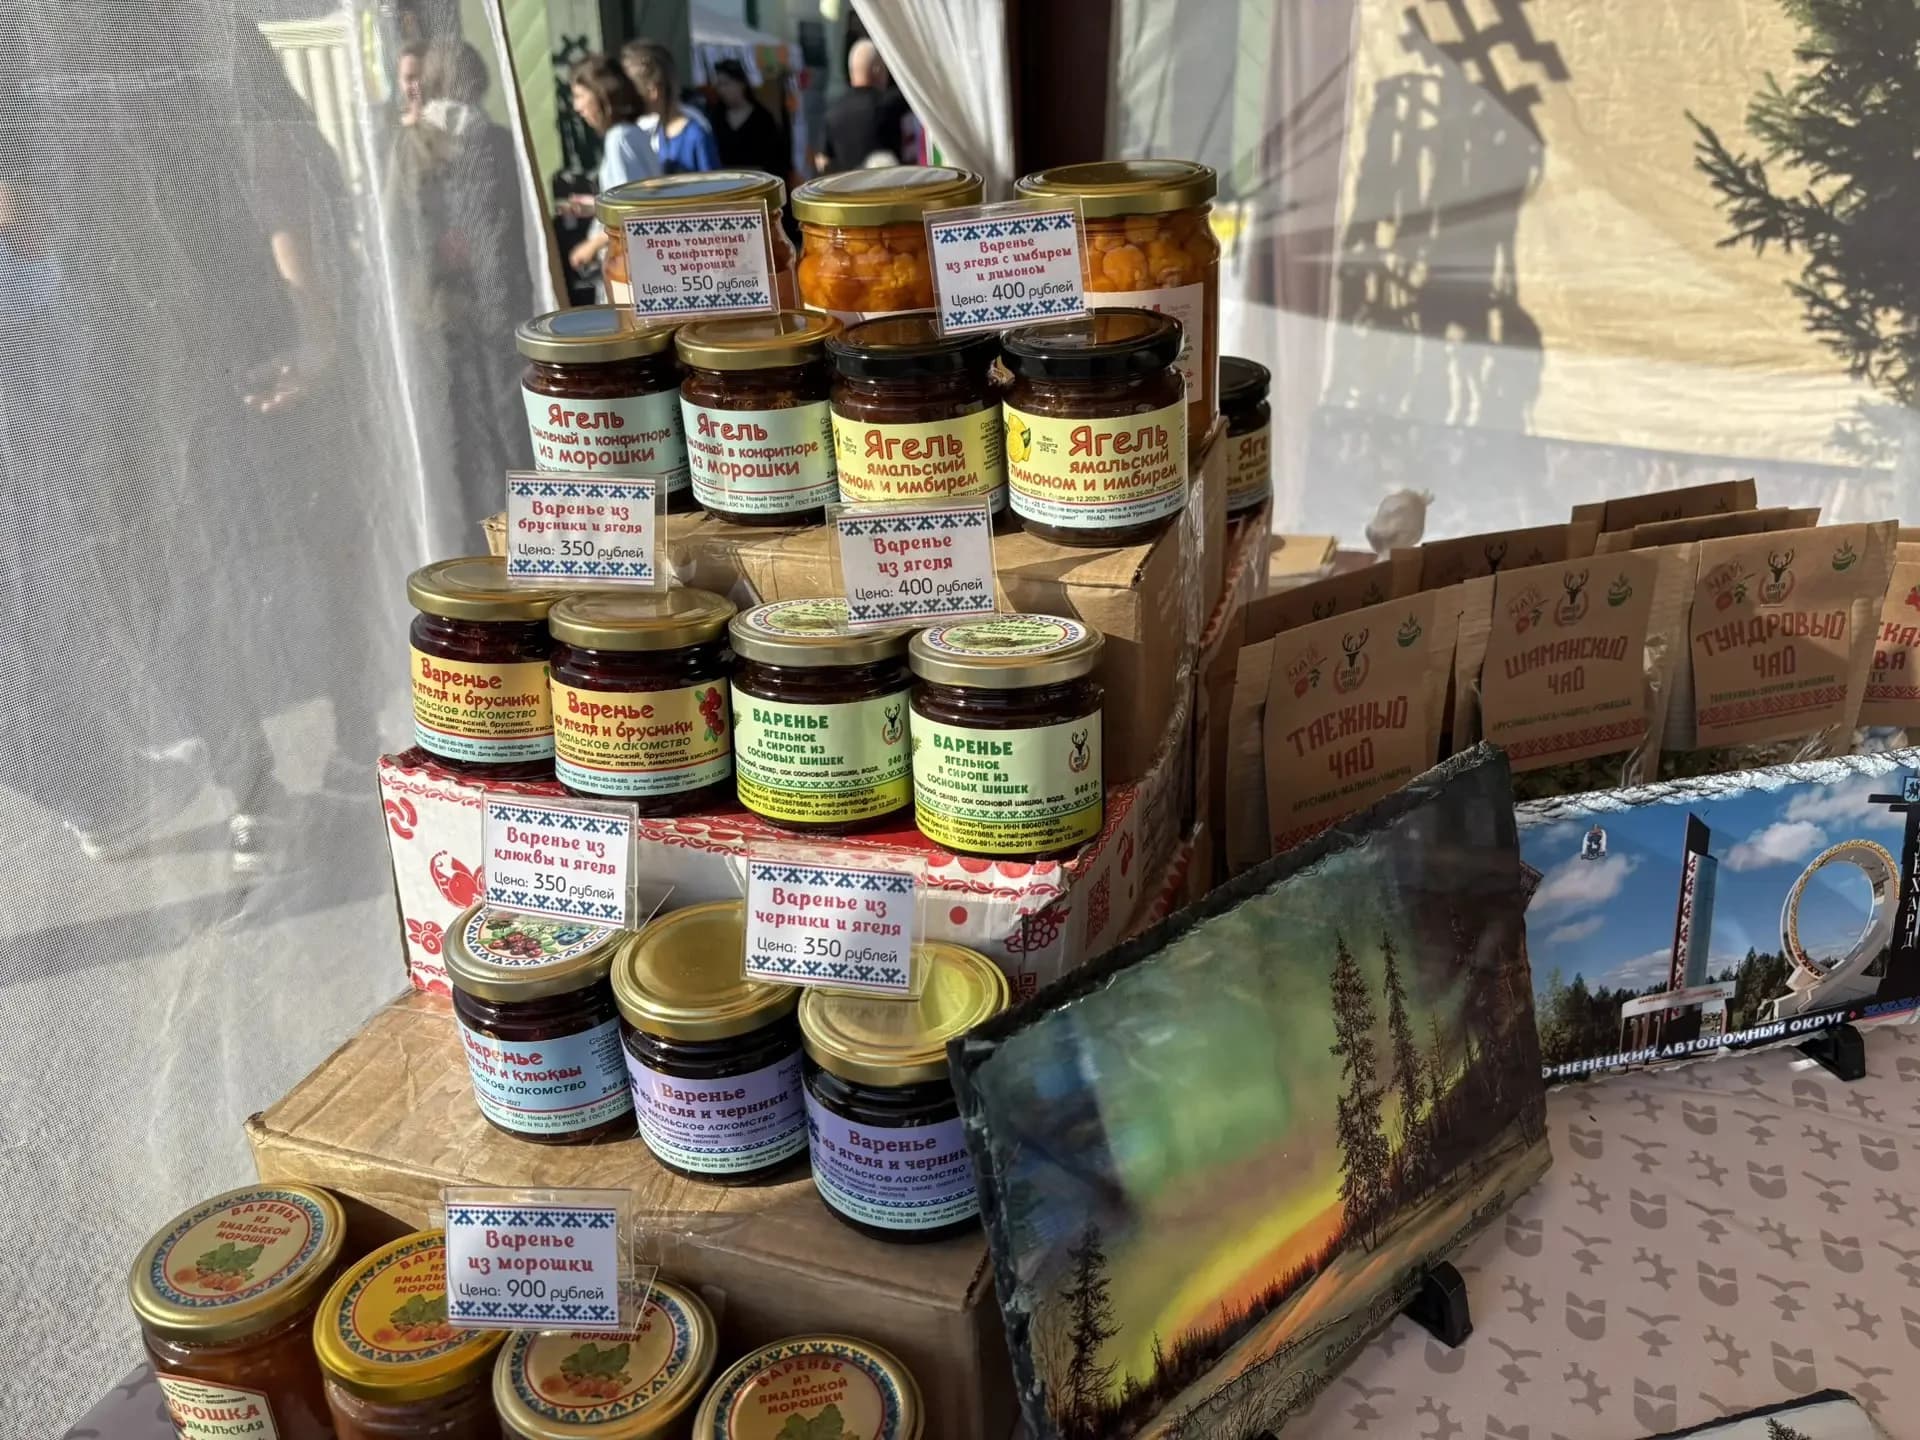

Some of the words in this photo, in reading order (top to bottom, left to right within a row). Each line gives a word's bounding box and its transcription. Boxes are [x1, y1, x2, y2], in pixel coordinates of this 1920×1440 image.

[647, 238, 681, 249] Ягель
[685, 233, 745, 246] томленый
[980, 237, 1034, 253] Варенье
[656, 249, 664, 260] в
[668, 247, 739, 261] конфитюре
[945, 261, 960, 274] из
[963, 256, 998, 270] ягеля
[1003, 254, 1009, 264] с
[1013, 247, 1072, 263] имбирем
[663, 264, 677, 275] из
[680, 259, 735, 273] морошки
[977, 271, 984, 281] и
[988, 264, 1045, 281] лимоном
[642, 283, 677, 295] Цена:
[682, 275, 713, 291] 550
[717, 276, 759, 293] рублей
[951, 293, 987, 308] Цена:
[992, 281, 1025, 300] 400
[1029, 280, 1074, 298] рублей
[548, 403, 625, 430] Ягель
[697, 412, 768, 442] Ягель
[584, 435, 591, 445] в
[595, 427, 672, 448] конфитюре
[865, 429, 963, 460] Ягель
[1069, 424, 1168, 457] Ягель
[539, 443, 553, 459] из
[559, 448, 655, 470] морошки
[728, 448, 735, 457] в
[739, 441, 819, 462] конфитюре
[1070, 445, 1169, 474] ямальский
[692, 454, 703, 470] из
[707, 461, 800, 482] морошки
[867, 454, 966, 477] ямальский
[880, 481, 890, 493] и
[897, 473, 978, 496] имбирем
[1010, 464, 1077, 491] лимоном
[1083, 479, 1096, 491] и
[1103, 464, 1177, 491] имбирем
[532, 500, 605, 518] Варенье
[611, 505, 630, 521] из
[518, 518, 587, 534] брусники
[592, 523, 600, 531] и
[604, 523, 642, 534] ягеля
[518, 543, 555, 556] Цена:
[560, 540, 595, 557] 350
[597, 546, 644, 560] рублей
[873, 535, 953, 555] Варенье
[877, 562, 899, 577] из
[903, 556, 953, 573] ягеля
[855, 587, 894, 601] Цена:
[898, 577, 933, 596] 400
[936, 577, 983, 596] рублей
[1696, 610, 1846, 657] ТУНДРОВЫЙ
[1505, 636, 1629, 680] ШАМАНСКИЙ
[1753, 645, 1796, 679] ЧАЙ
[421, 657, 502, 689] Варенье
[1548, 665, 1585, 695] ЧАЙ
[418, 682, 448, 702] ягеля
[452, 692, 460, 703] и
[465, 690, 540, 710] брусники
[567, 690, 655, 723] Варенье
[462, 709, 537, 720] лакомство
[753, 708, 829, 729] ВАРЕНЬЕ
[564, 718, 598, 737] ягеля
[602, 726, 611, 737] и
[616, 720, 693, 742] брусники
[763, 729, 816, 743] ЯГЕЛЬНОЕ
[1286, 695, 1409, 759] ТАЕЖНЫЙ
[613, 737, 691, 751] лакомство
[758, 738, 764, 747] В
[766, 741, 806, 754] СИРОПЕ
[811, 745, 825, 754] ИЗ
[933, 733, 1013, 756] ВАРЕНЬЕ
[747, 746, 795, 765] СОСНОВЫХ
[800, 756, 844, 766] ШИШЕК
[944, 755, 1000, 770] ЯГЕЛЬНОЕ
[1328, 737, 1375, 780] ЧАЙ
[927, 773, 977, 793] СОСНОВЫХ
[982, 784, 1029, 795] ШИШЕК
[938, 765, 944, 774] В
[947, 767, 989, 782] СИРОПЕ
[994, 772, 1009, 782] ИЗ
[975, 799, 1012, 807] сосновой
[506, 826, 580, 850] Варенье
[586, 840, 605, 858] из
[494, 848, 555, 866] клюквы
[560, 857, 569, 868] и
[573, 859, 616, 875] ягеля
[494, 871, 529, 888] Цена:
[533, 872, 567, 893] 350
[569, 885, 615, 900] рублей
[772, 887, 857, 911] Варенье
[864, 899, 887, 919] из
[755, 910, 830, 929] черники
[836, 919, 846, 930] и
[851, 920, 901, 937] ягеля
[757, 936, 798, 953] Цена:
[803, 937, 842, 958] 350
[844, 947, 898, 963] рублей
[1660, 1021, 1786, 1057] АВТОНОМНЫЙ
[1790, 1010, 1844, 1032] ОКРУГ
[463, 1029, 544, 1066] Варенье
[500, 1069, 509, 1080] и
[513, 1066, 583, 1082] клюквы
[508, 1080, 587, 1095] лакомство
[661, 1082, 746, 1105] Варенье
[654, 1101, 696, 1119] ягеля
[701, 1109, 711, 1119] и
[715, 1091, 788, 1120] черники
[648, 1107, 705, 1131] ямальское
[707, 1112, 776, 1132] лакомство
[848, 1129, 937, 1153] Варенье
[822, 1136, 836, 1151] из
[839, 1148, 884, 1170] ягеля
[888, 1158, 900, 1170] и
[904, 1148, 968, 1171] черник
[829, 1156, 892, 1184] ямальское
[895, 1164, 966, 1184] лакомство
[230, 1202, 302, 1224] ВАРЕНЬЕ
[253, 1216, 270, 1224] ИЗ
[216, 1231, 278, 1245] МОРОШКИ
[217, 1220, 291, 1236] ЯМАЛЬСКОЙ
[485, 1230, 575, 1251] Варенье
[468, 1256, 490, 1275] из
[497, 1256, 594, 1275] морошки
[393, 1273, 447, 1284] ЯМАЛЬС
[459, 1282, 501, 1297] Цена:
[506, 1279, 546, 1298] 900
[550, 1286, 604, 1302] рублей
[570, 1332, 641, 1343] МОРОШКИ
[756, 1359, 845, 1388] ВАРЕНЬЕ
[792, 1375, 811, 1386] ИЗ
[758, 1377, 849, 1404] ЯМАЛЬСКОЙ
[767, 1392, 844, 1415] МОРОШКИ
[186, 1420, 265, 1436] ЯМАЛЬСКАЯ
